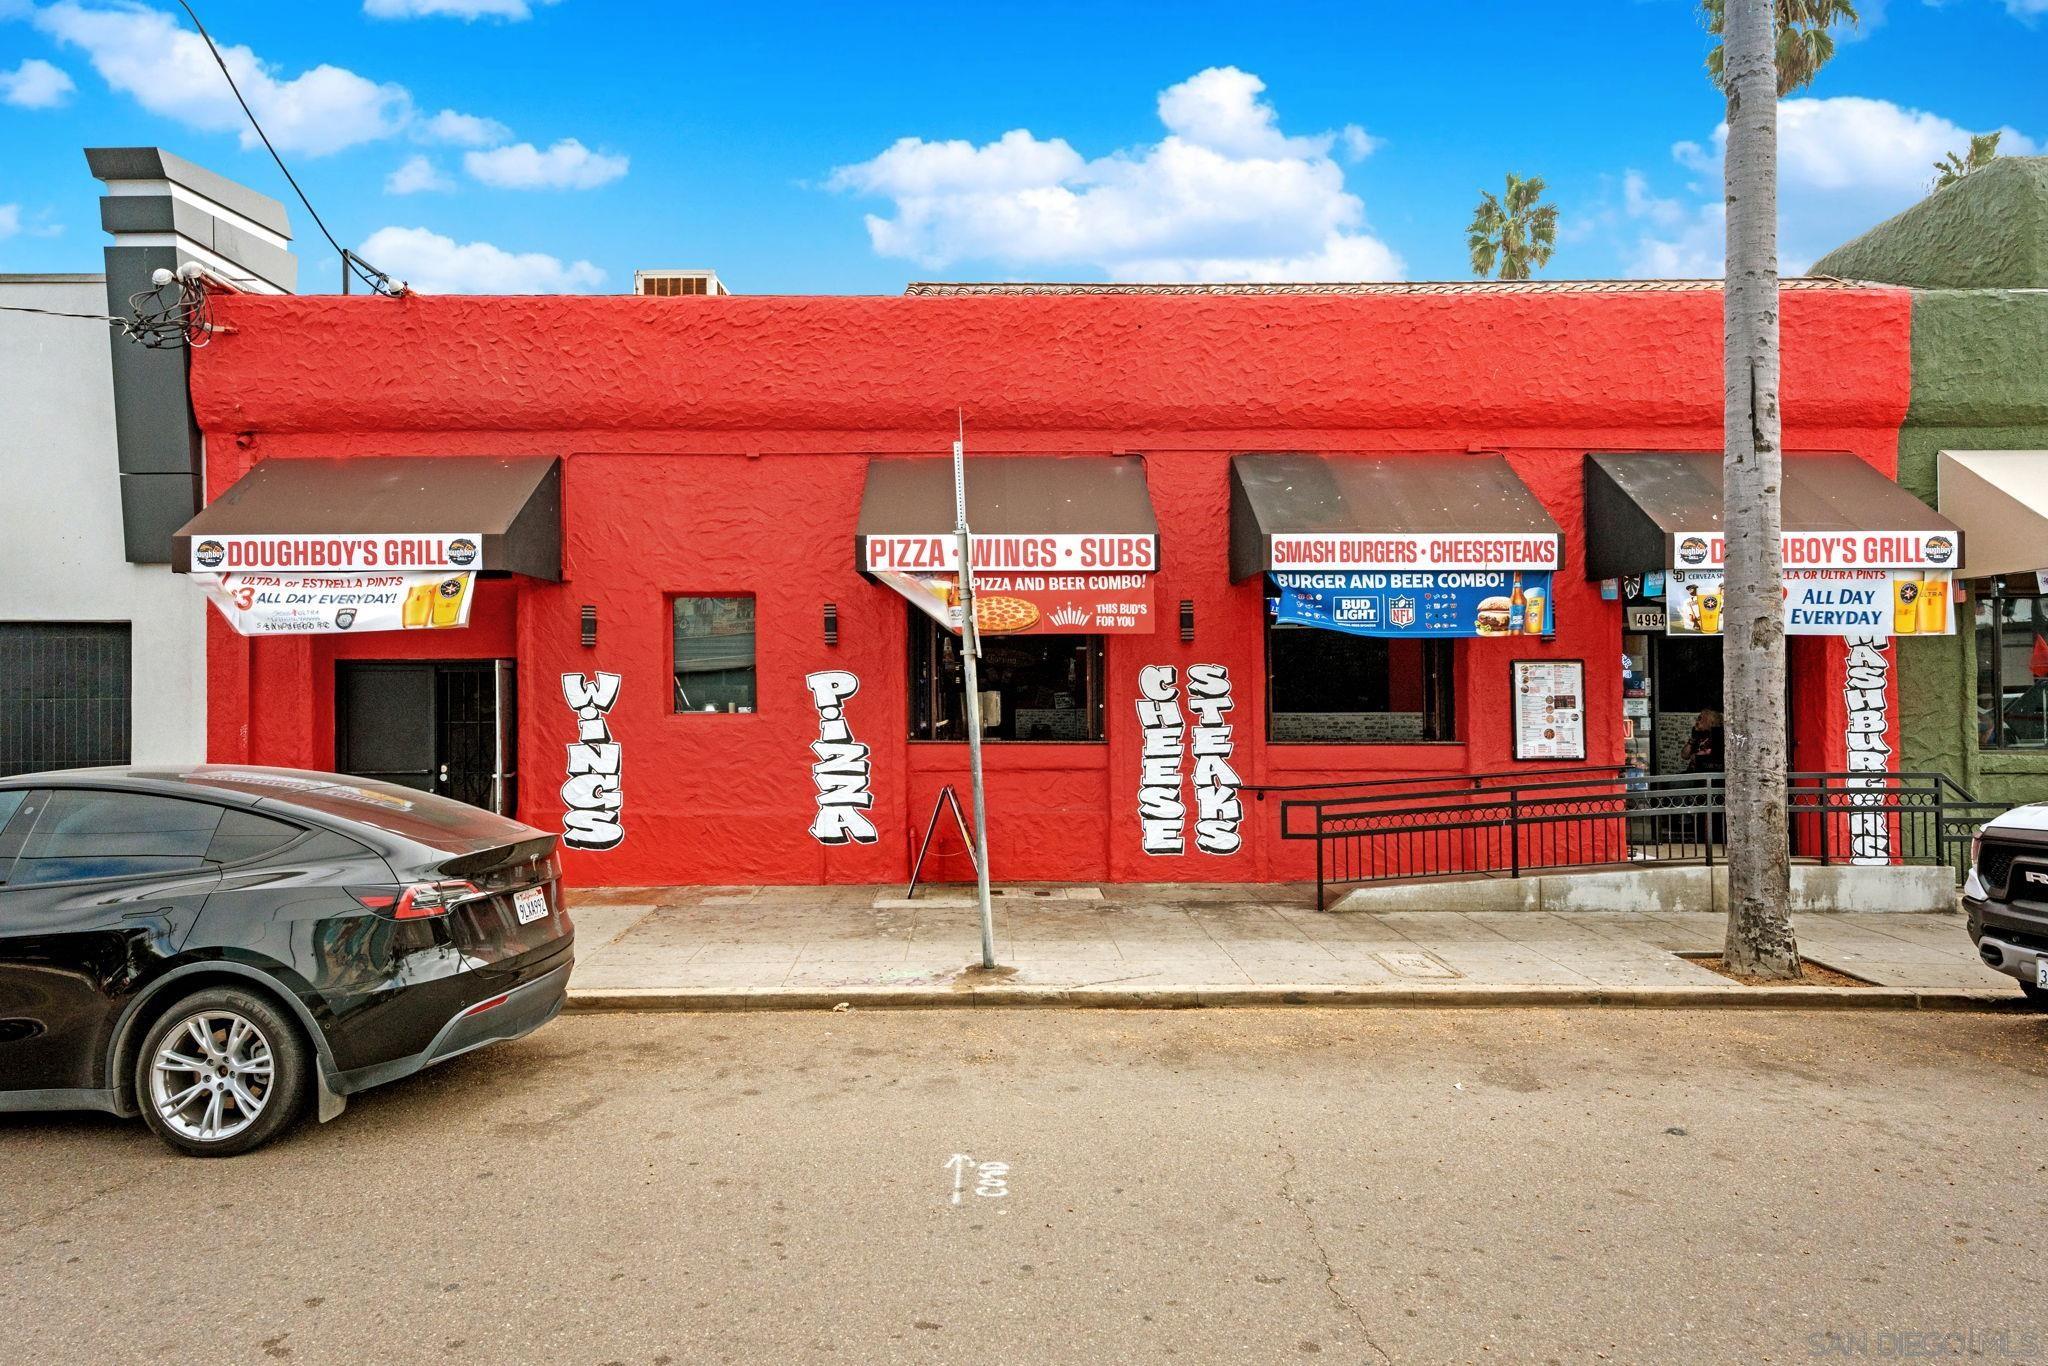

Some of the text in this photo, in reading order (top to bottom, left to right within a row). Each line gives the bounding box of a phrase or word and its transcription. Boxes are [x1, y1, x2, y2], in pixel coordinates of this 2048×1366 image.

[228, 539, 448, 566] DOUGHBOY'S GRILL
[870, 538, 1152, 567] PIZZA WINGS SUBS
[1274, 540, 1555, 563] SMASH BURGERS CHEESESTEAKS
[1863, 537, 1925, 563] GRILL
[241, 576, 281, 586] ULTRA
[301, 578, 363, 588] ESTRELLA
[366, 576, 404, 588] PINTS
[973, 574, 1147, 591] PIZZA AND BEER COMBO!
[1277, 572, 1505, 589] BURGER AND BEER COMBO!
[1803, 570, 1817, 580] OR
[1820, 569, 1853, 580] ULTRA
[1856, 570, 1886, 580] PINTS
[256, 592, 397, 605] ALL DAY EVERYDAY!
[1341, 599, 1371, 609] BUD
[1802, 588, 1875, 605] ALL DAY
[1096, 603, 1147, 615] THIS BUD'S
[1336, 609, 1376, 620] LIGHT
[1392, 608, 1412, 622] NFL
[1791, 608, 1882, 625] EVERYDAY
[1096, 616, 1135, 627] FOR YOU
[1637, 613, 1665, 627] 4994
[1135, 663, 1186, 856] CHEESE
[1186, 663, 1244, 855] STEAKS
